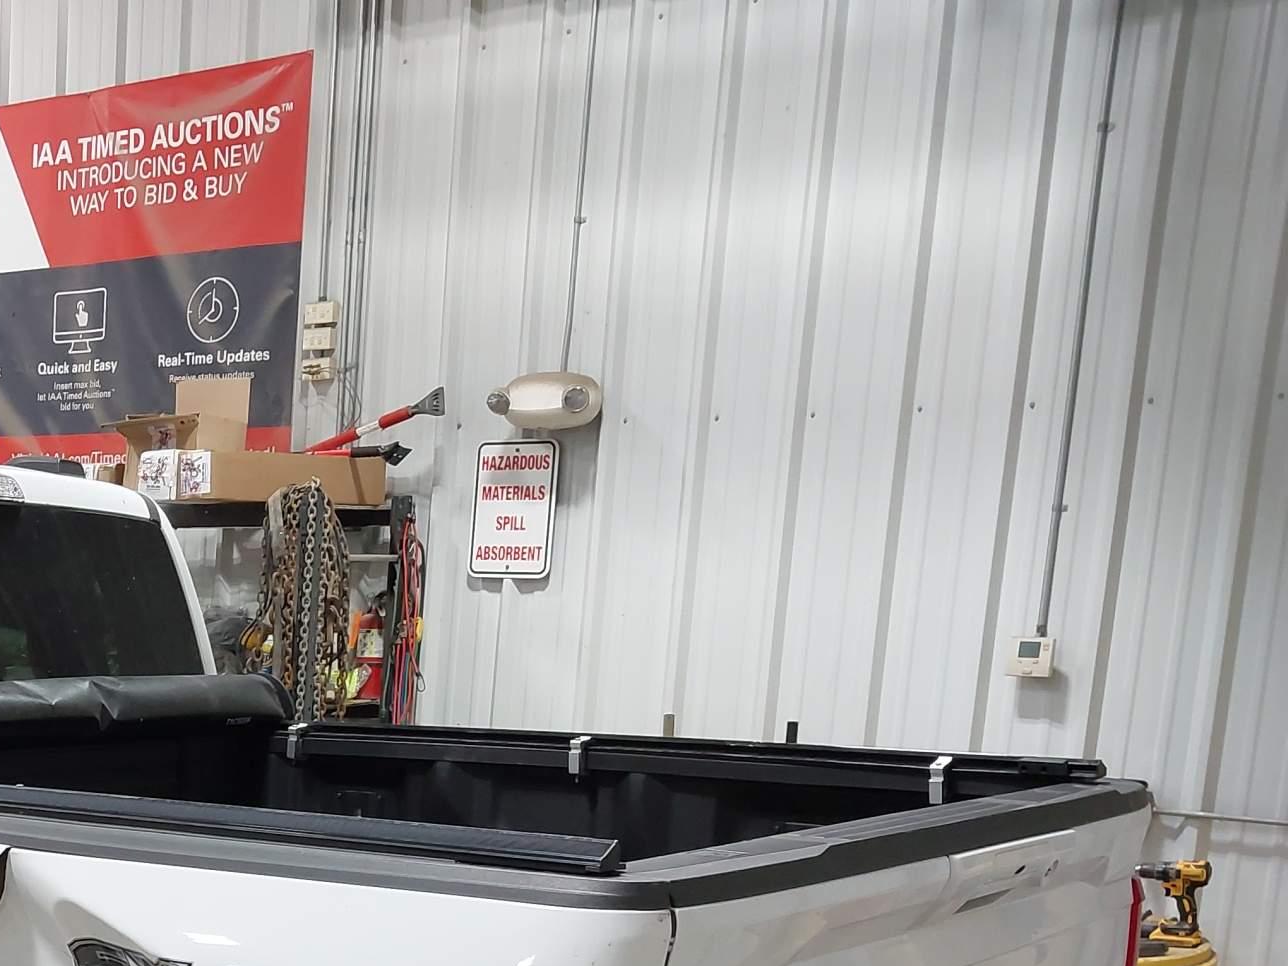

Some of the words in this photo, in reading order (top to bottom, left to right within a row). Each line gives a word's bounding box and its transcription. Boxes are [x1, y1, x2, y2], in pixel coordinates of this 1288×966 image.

[32, 141, 72, 168] IAA
[78, 128, 144, 161] TIMED
[57, 154, 185, 191] INTRODUCING
[192, 150, 207, 171] A
[213, 142, 264, 168] NEW
[70, 191, 111, 217] WAY
[113, 187, 137, 208] TO
[144, 181, 176, 206] BID
[183, 179, 199, 201] &
[205, 172, 248, 199] BUY
[158, 352, 213, 367] Real-Time
[216, 349, 270, 365] Updates
[38, 362, 69, 376] Quick
[71, 361, 91, 373] and
[93, 359, 117, 374] Easy
[74, 381, 87, 389] max
[48, 391, 62, 401] IAA
[63, 391, 82, 400] Timed
[60, 402, 70, 411] bid
[71, 401, 81, 410] for
[82, 402, 94, 411] you
[482, 454, 550, 471] HAZARDOUS
[482, 485, 546, 501] MATERIALS
[495, 516, 527, 531] SPILL
[475, 545, 543, 561] ABSORBENT
